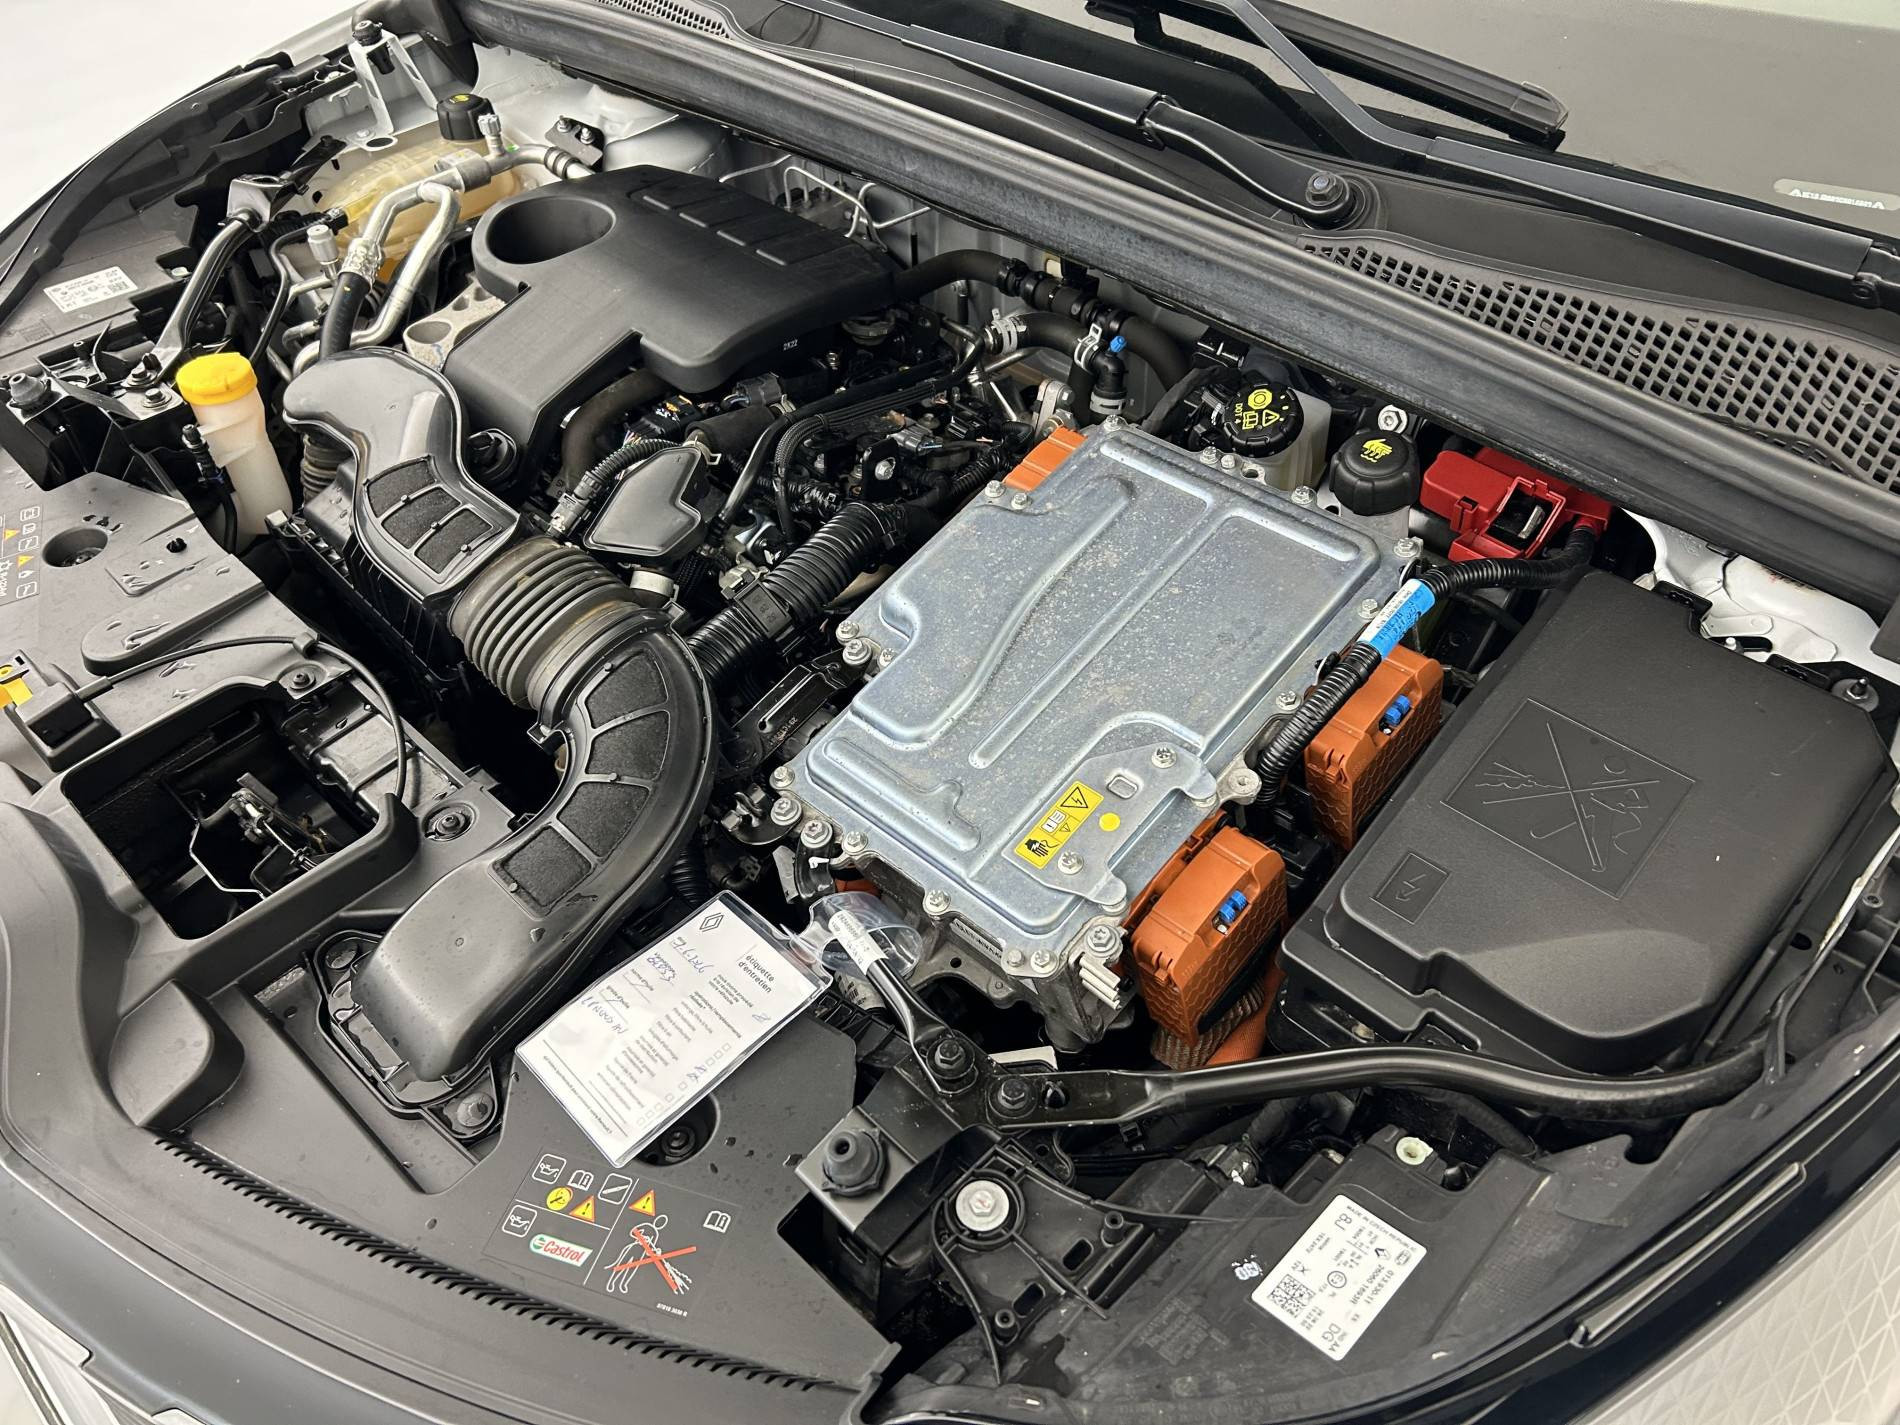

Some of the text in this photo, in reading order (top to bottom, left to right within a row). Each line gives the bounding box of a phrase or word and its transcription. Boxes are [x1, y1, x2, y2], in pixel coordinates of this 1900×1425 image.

[1234, 403, 1243, 417] DOT
[736, 960, 774, 993] d'entretien
[743, 954, 776, 982] étiquette
[1333, 1212, 1354, 1231] 8J
[543, 1240, 587, 1263] Castrol
[1320, 1322, 1341, 1343] DG
